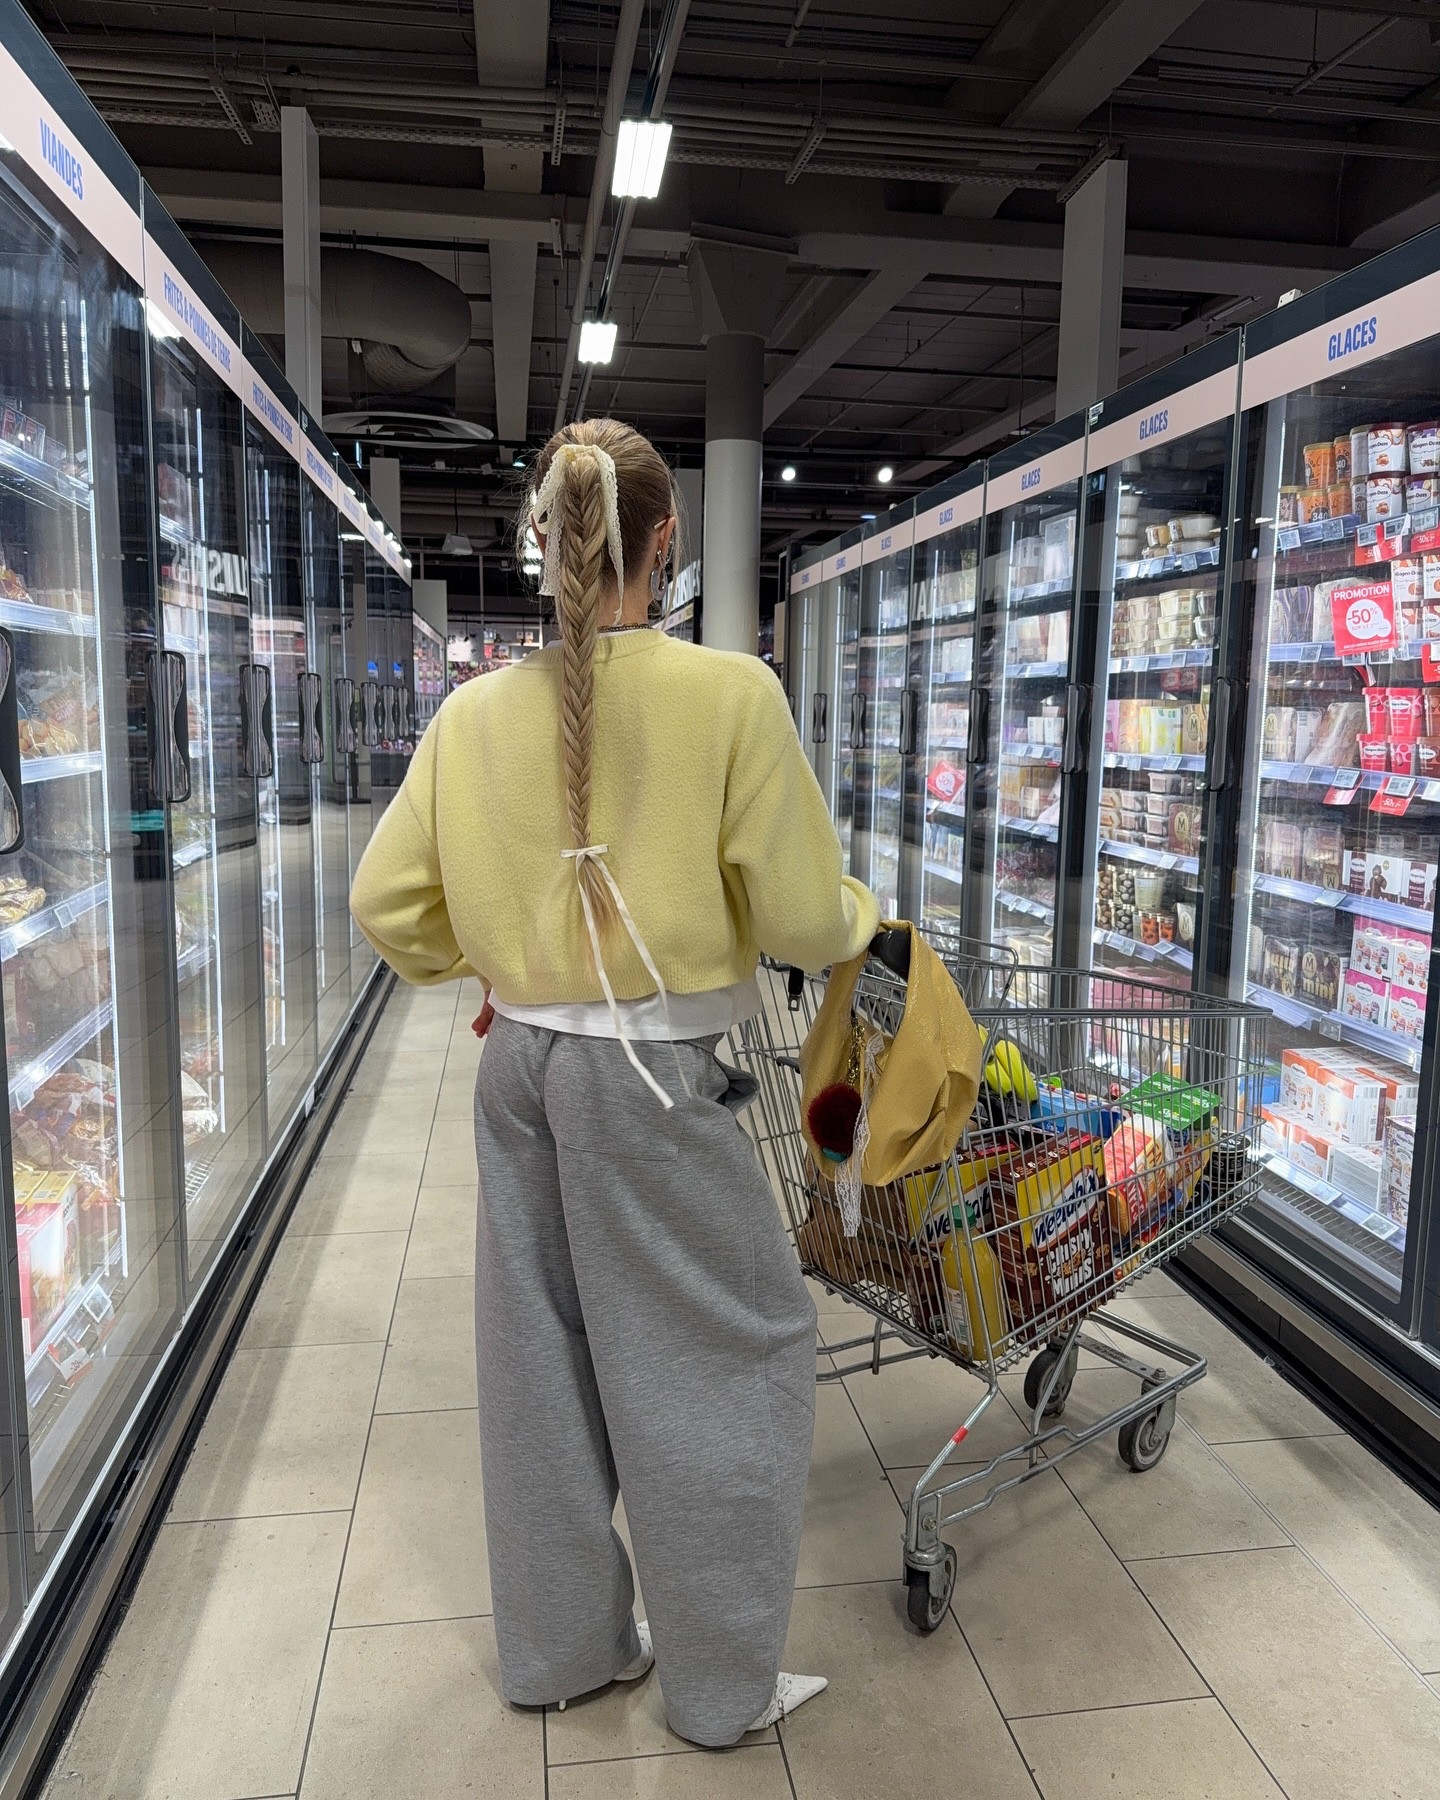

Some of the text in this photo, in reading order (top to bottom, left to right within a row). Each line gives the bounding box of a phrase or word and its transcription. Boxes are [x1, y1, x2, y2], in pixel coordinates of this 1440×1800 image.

[40, 117, 83, 201] VIANDES
[164, 271, 184, 319] FRITES
[1328, 316, 1377, 361] GLACES
[1139, 409, 1169, 441] GLACES
[1021, 467, 1041, 491] GLACES
[1334, 584, 1390, 601] PROMOTION
[1347, 606, 1378, 625] -50%
[1302, 975, 1335, 1001] mini
